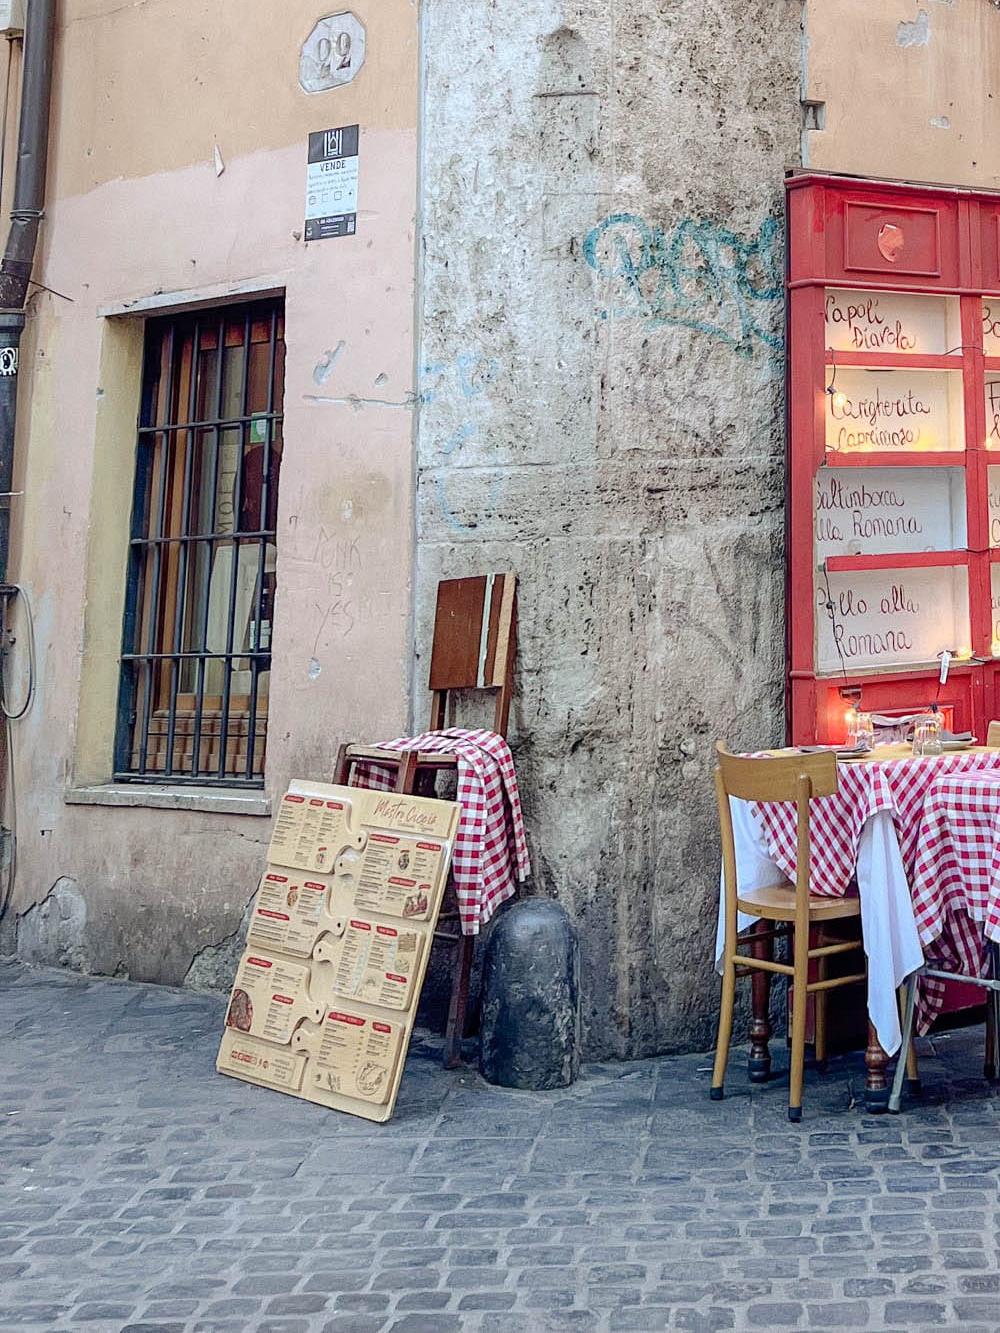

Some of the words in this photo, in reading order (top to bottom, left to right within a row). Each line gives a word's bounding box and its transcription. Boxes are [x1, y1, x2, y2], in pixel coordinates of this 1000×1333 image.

[320, 160, 346, 172] VENDE
[853, 510, 923, 538] Romana
[835, 623, 912, 658] Romana
